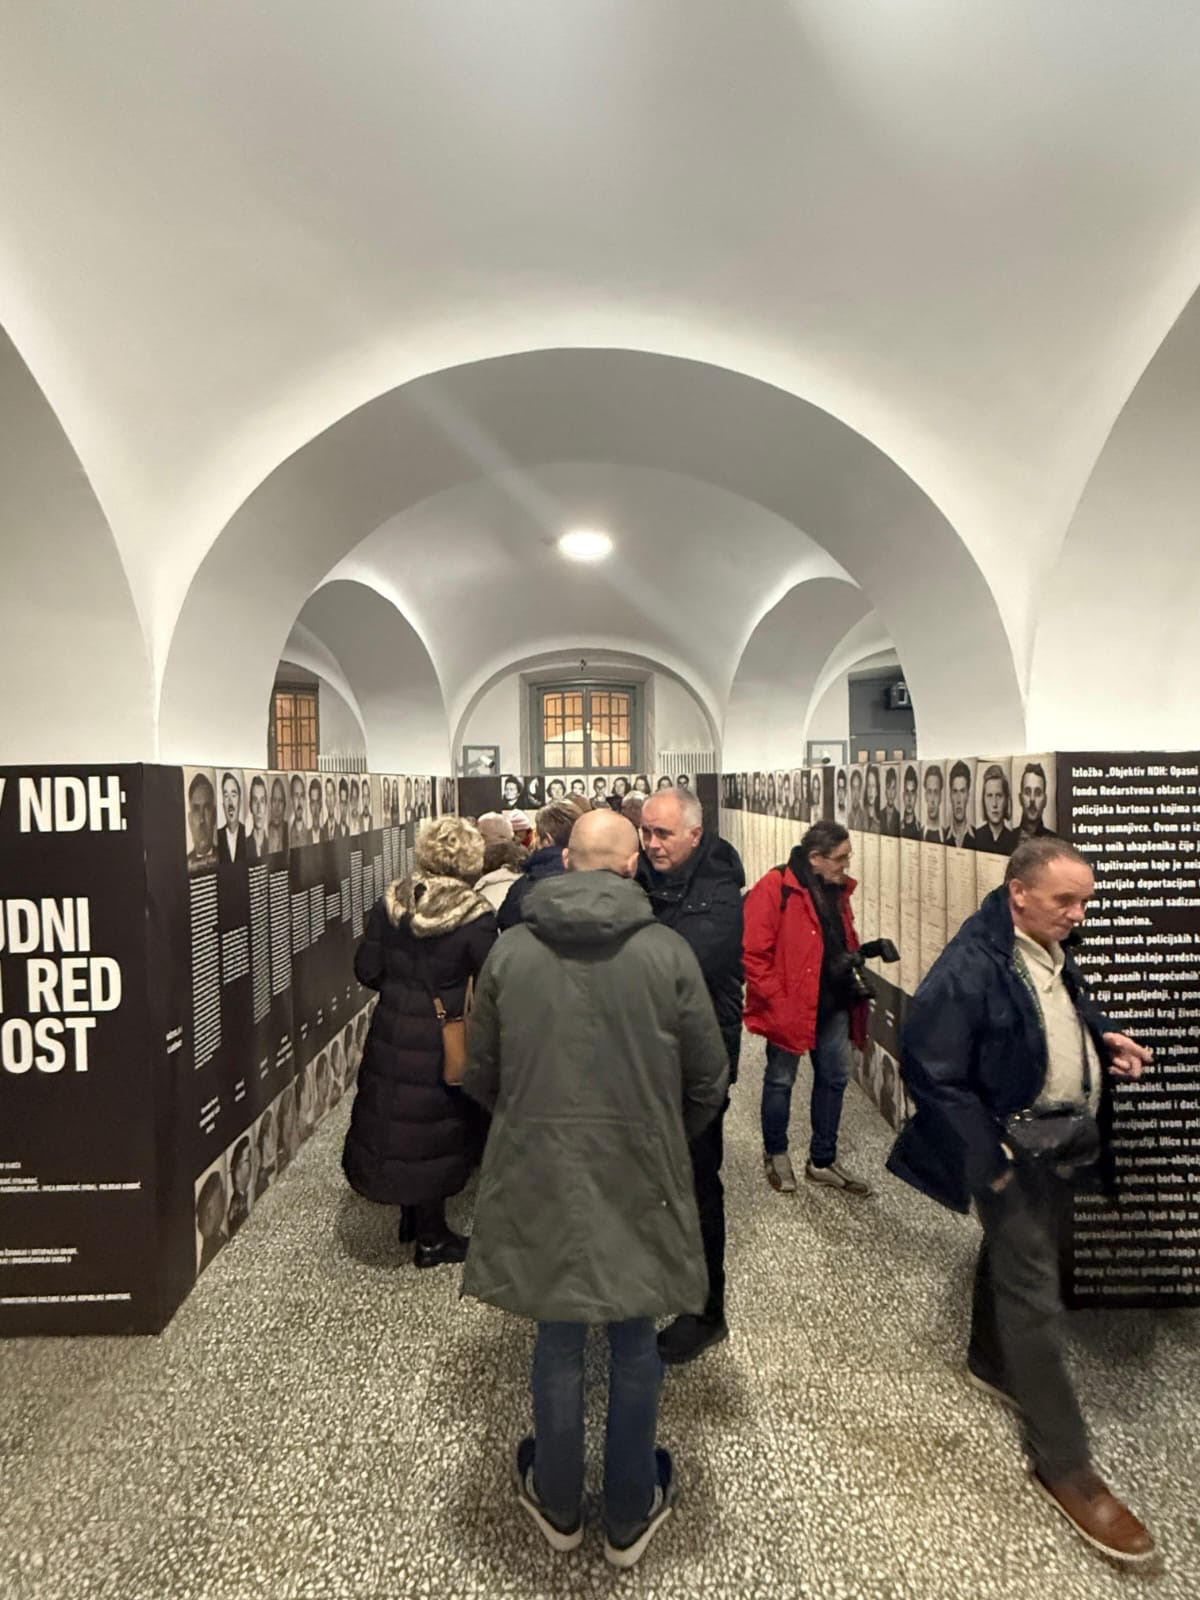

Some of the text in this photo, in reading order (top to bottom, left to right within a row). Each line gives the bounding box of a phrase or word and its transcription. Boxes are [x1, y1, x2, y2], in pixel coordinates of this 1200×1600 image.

[1072, 767, 1103, 778] Izložba
[1147, 765, 1168, 777] NDH:
[1170, 765, 1198, 778] Opasni
[1100, 785, 1154, 796] Redarstvena
[1156, 784, 1184, 795] oblast
[1187, 786, 1196, 795] za
[19, 776, 127, 832] NDH:
[1072, 804, 1114, 817] policijska
[1116, 804, 1150, 814] kartona
[1152, 806, 1158, 814] u
[1160, 803, 1190, 816] kojima
[1072, 822, 1076, 834] i
[1078, 823, 1103, 836] druge
[1153, 822, 1178, 832] Ovom
[1105, 841, 1124, 852] onih
[1178, 840, 1195, 853] čije
[1097, 859, 1149, 872] ispitivanjem
[1151, 859, 1170, 872] koje
[1172, 859, 1182, 872] je
[1137, 878, 1196, 891] deportacijom
[1102, 897, 1111, 910] je
[1113, 896, 1163, 910] organizirani
[0, 897, 91, 953] DNI
[1115, 934, 1144, 945] uzorak
[1146, 933, 1192, 946] policijskih
[27, 957, 122, 1013] RED
[1, 1016, 97, 1074] OST
